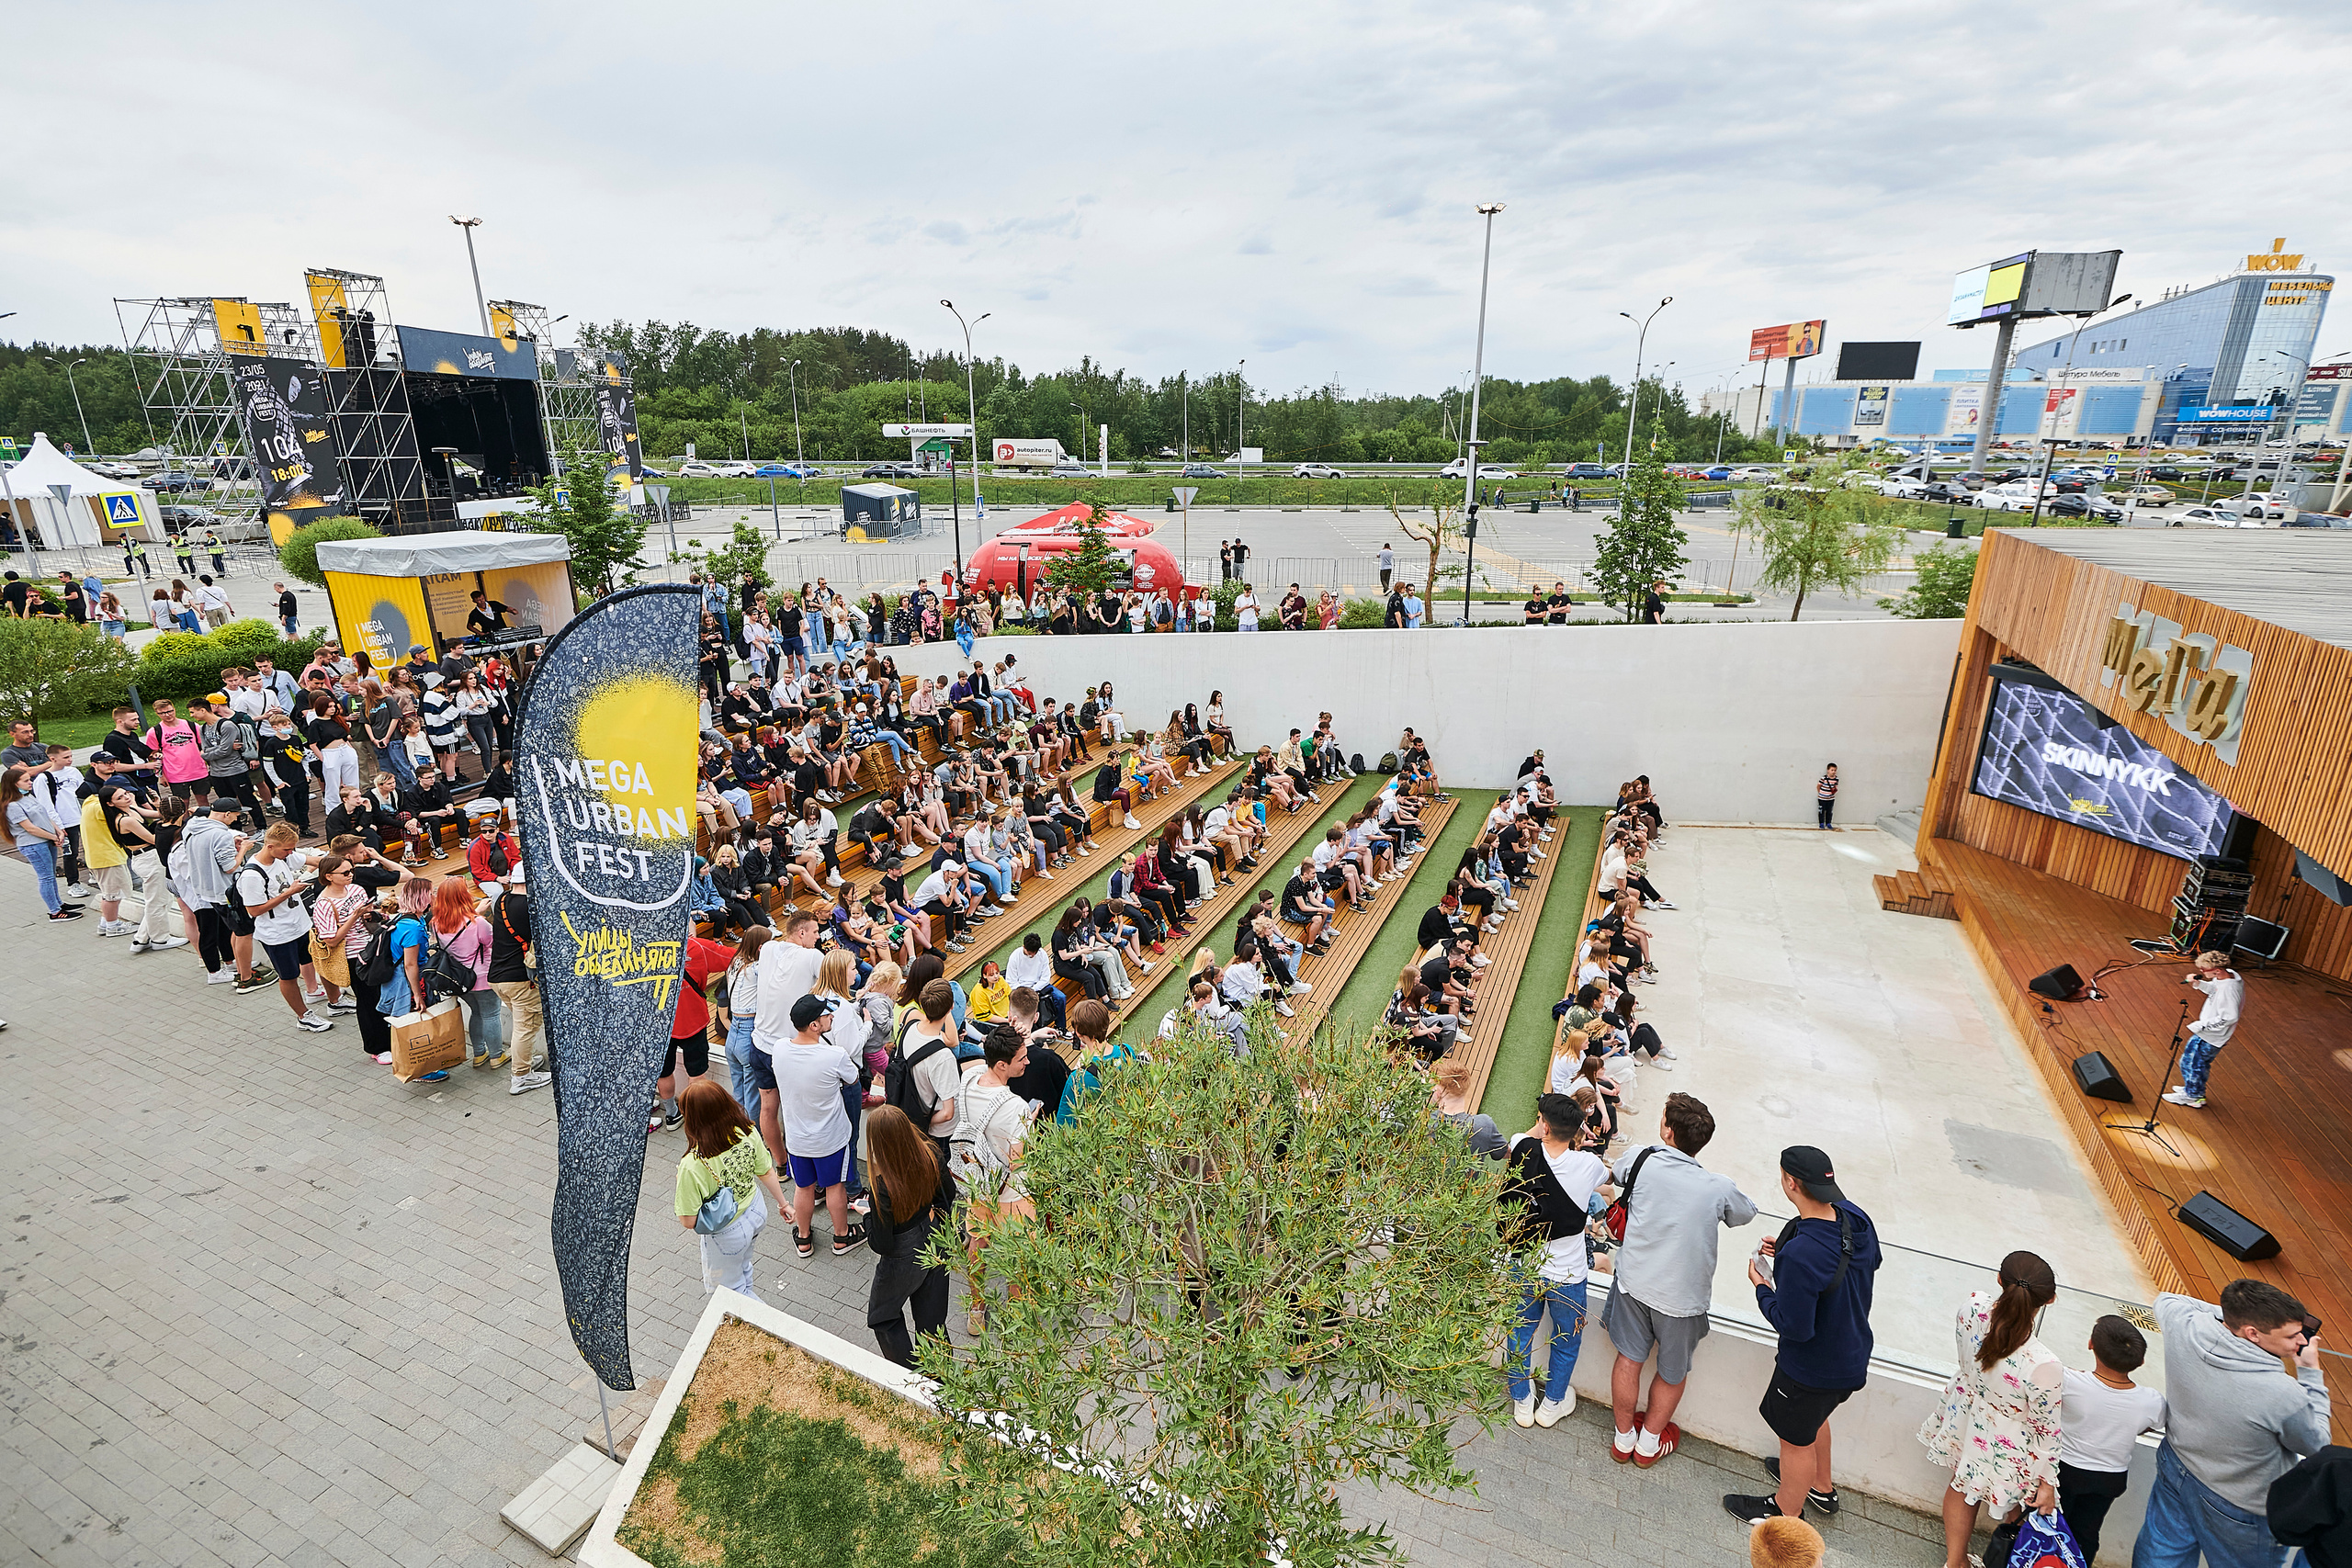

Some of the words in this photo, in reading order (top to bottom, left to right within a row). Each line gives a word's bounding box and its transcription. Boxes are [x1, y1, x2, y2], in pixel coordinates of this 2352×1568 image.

[2247, 254, 2304, 271] WOW
[2265, 296, 2308, 306] ЦЕНТР
[239, 363, 266, 377] 23/05
[2057, 370, 2088, 379] Шатура
[245, 379, 266, 392] 2021
[598, 389, 611, 399] 23/05
[255, 402, 275, 411] URBAN
[257, 410, 272, 418] FEST
[2199, 409, 2268, 418] WOWHOUSE
[260, 432, 304, 463] 104
[605, 435, 626, 454] 104
[270, 463, 304, 483] 18:00
[360, 619, 385, 633] MEGA
[365, 632, 394, 648] URBAN
[368, 648, 390, 661] FEST
[553, 757, 655, 795] MEGA
[2041, 741, 2178, 797] SKINNYKK
[565, 799, 689, 840] URBAN
[575, 840, 653, 882] FEST
[574, 941, 682, 980] ОБЪЕДИНЯЮТ
